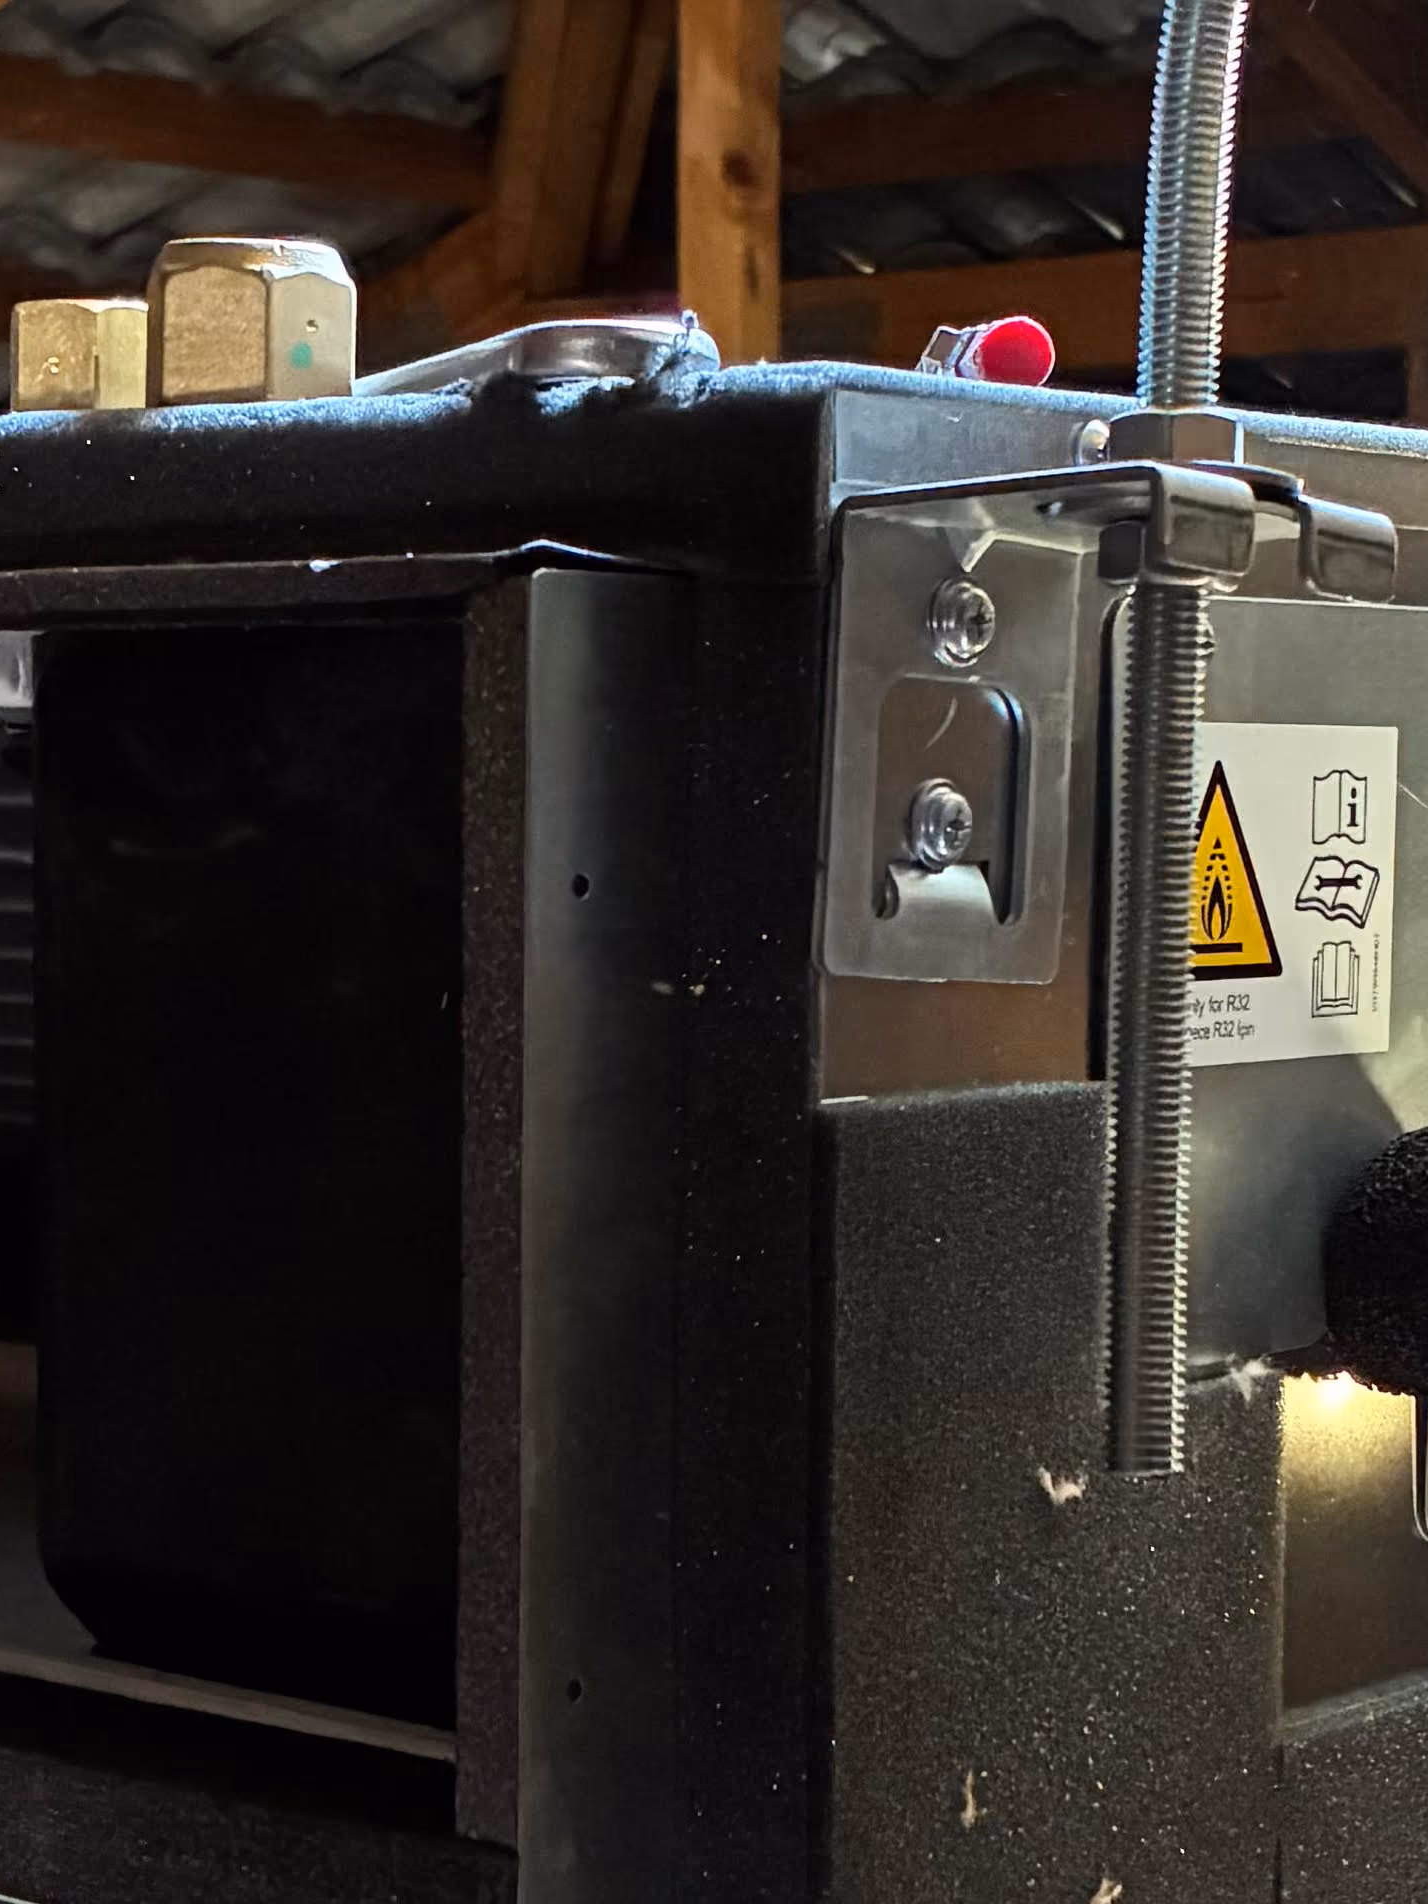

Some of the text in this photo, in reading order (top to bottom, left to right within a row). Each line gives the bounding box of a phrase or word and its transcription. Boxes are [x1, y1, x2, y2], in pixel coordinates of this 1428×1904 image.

[1208, 995, 1224, 1013] for
[1226, 993, 1251, 1013] R32
[1213, 1020, 1235, 1039] R32
